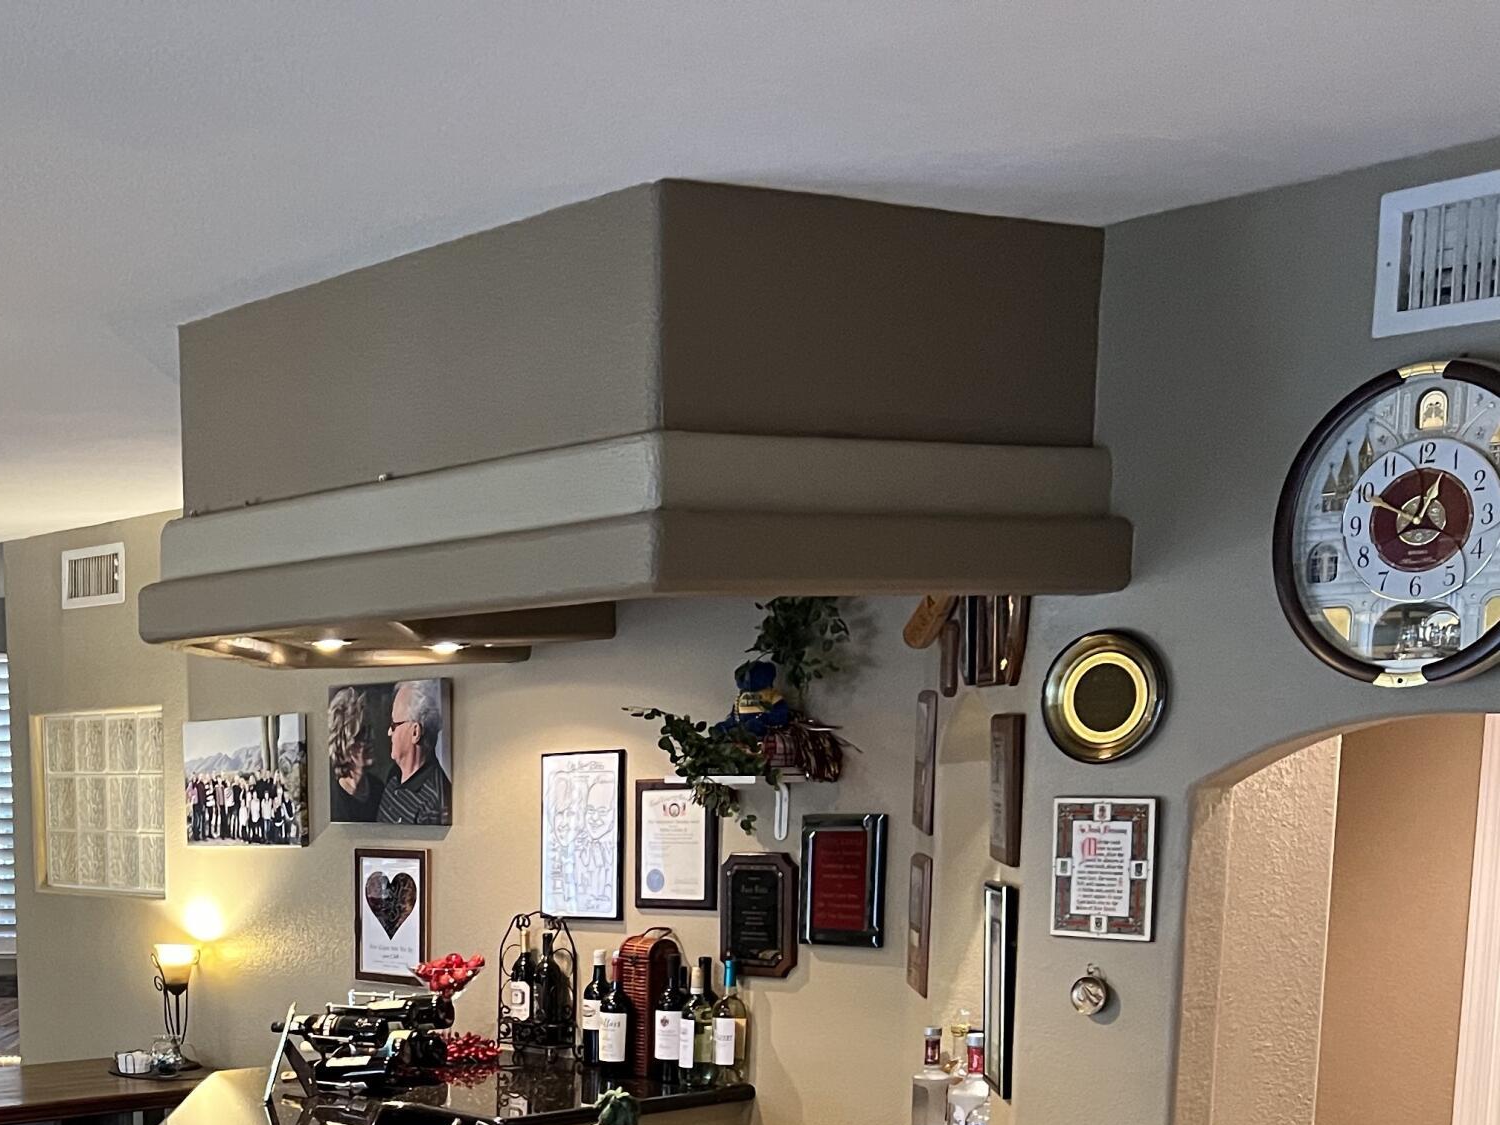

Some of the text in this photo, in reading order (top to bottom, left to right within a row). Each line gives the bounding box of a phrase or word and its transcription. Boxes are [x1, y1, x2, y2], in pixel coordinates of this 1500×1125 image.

[1419, 442, 1437, 464] 12
[1453, 449, 1459, 470] 1
[1384, 455, 1396, 478] 11
[1473, 470, 1486, 492] 2
[1357, 482, 1375, 504] 10
[1481, 503, 1493, 524] 3
[1350, 516, 1362, 537] 9
[1357, 545, 1370, 568] 8
[1470, 537, 1484, 559] 4
[1378, 570, 1390, 591] 7
[1443, 565, 1456, 586] 5
[1409, 576, 1421, 597] 6
